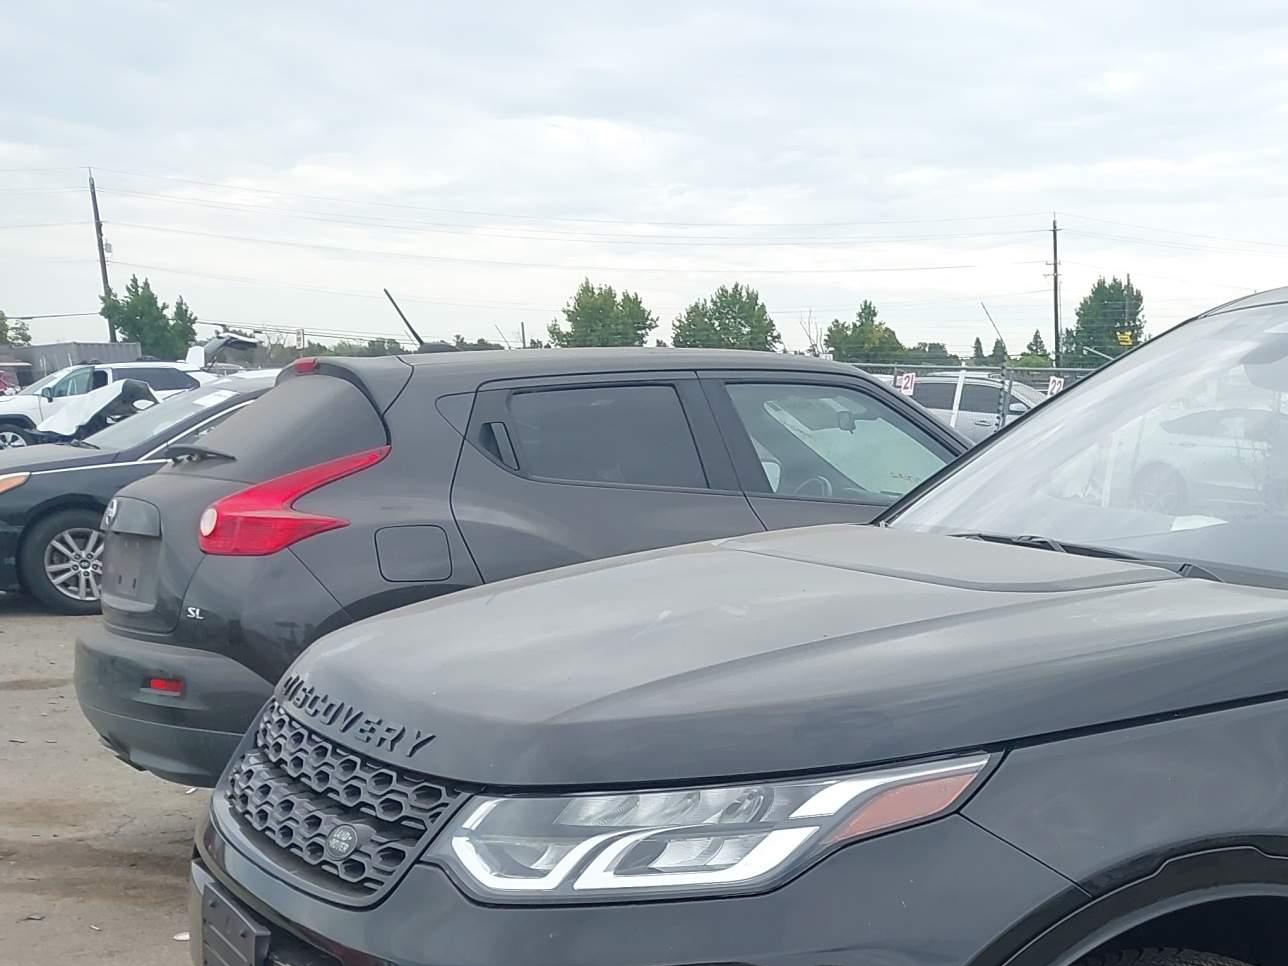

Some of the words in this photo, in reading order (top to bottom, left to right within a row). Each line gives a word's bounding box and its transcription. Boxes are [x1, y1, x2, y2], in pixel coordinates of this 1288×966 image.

[903, 375, 915, 390] 21
[1049, 379, 1062, 395] 22
[186, 606, 205, 620] SL
[283, 674, 437, 758] DISCOVERY
